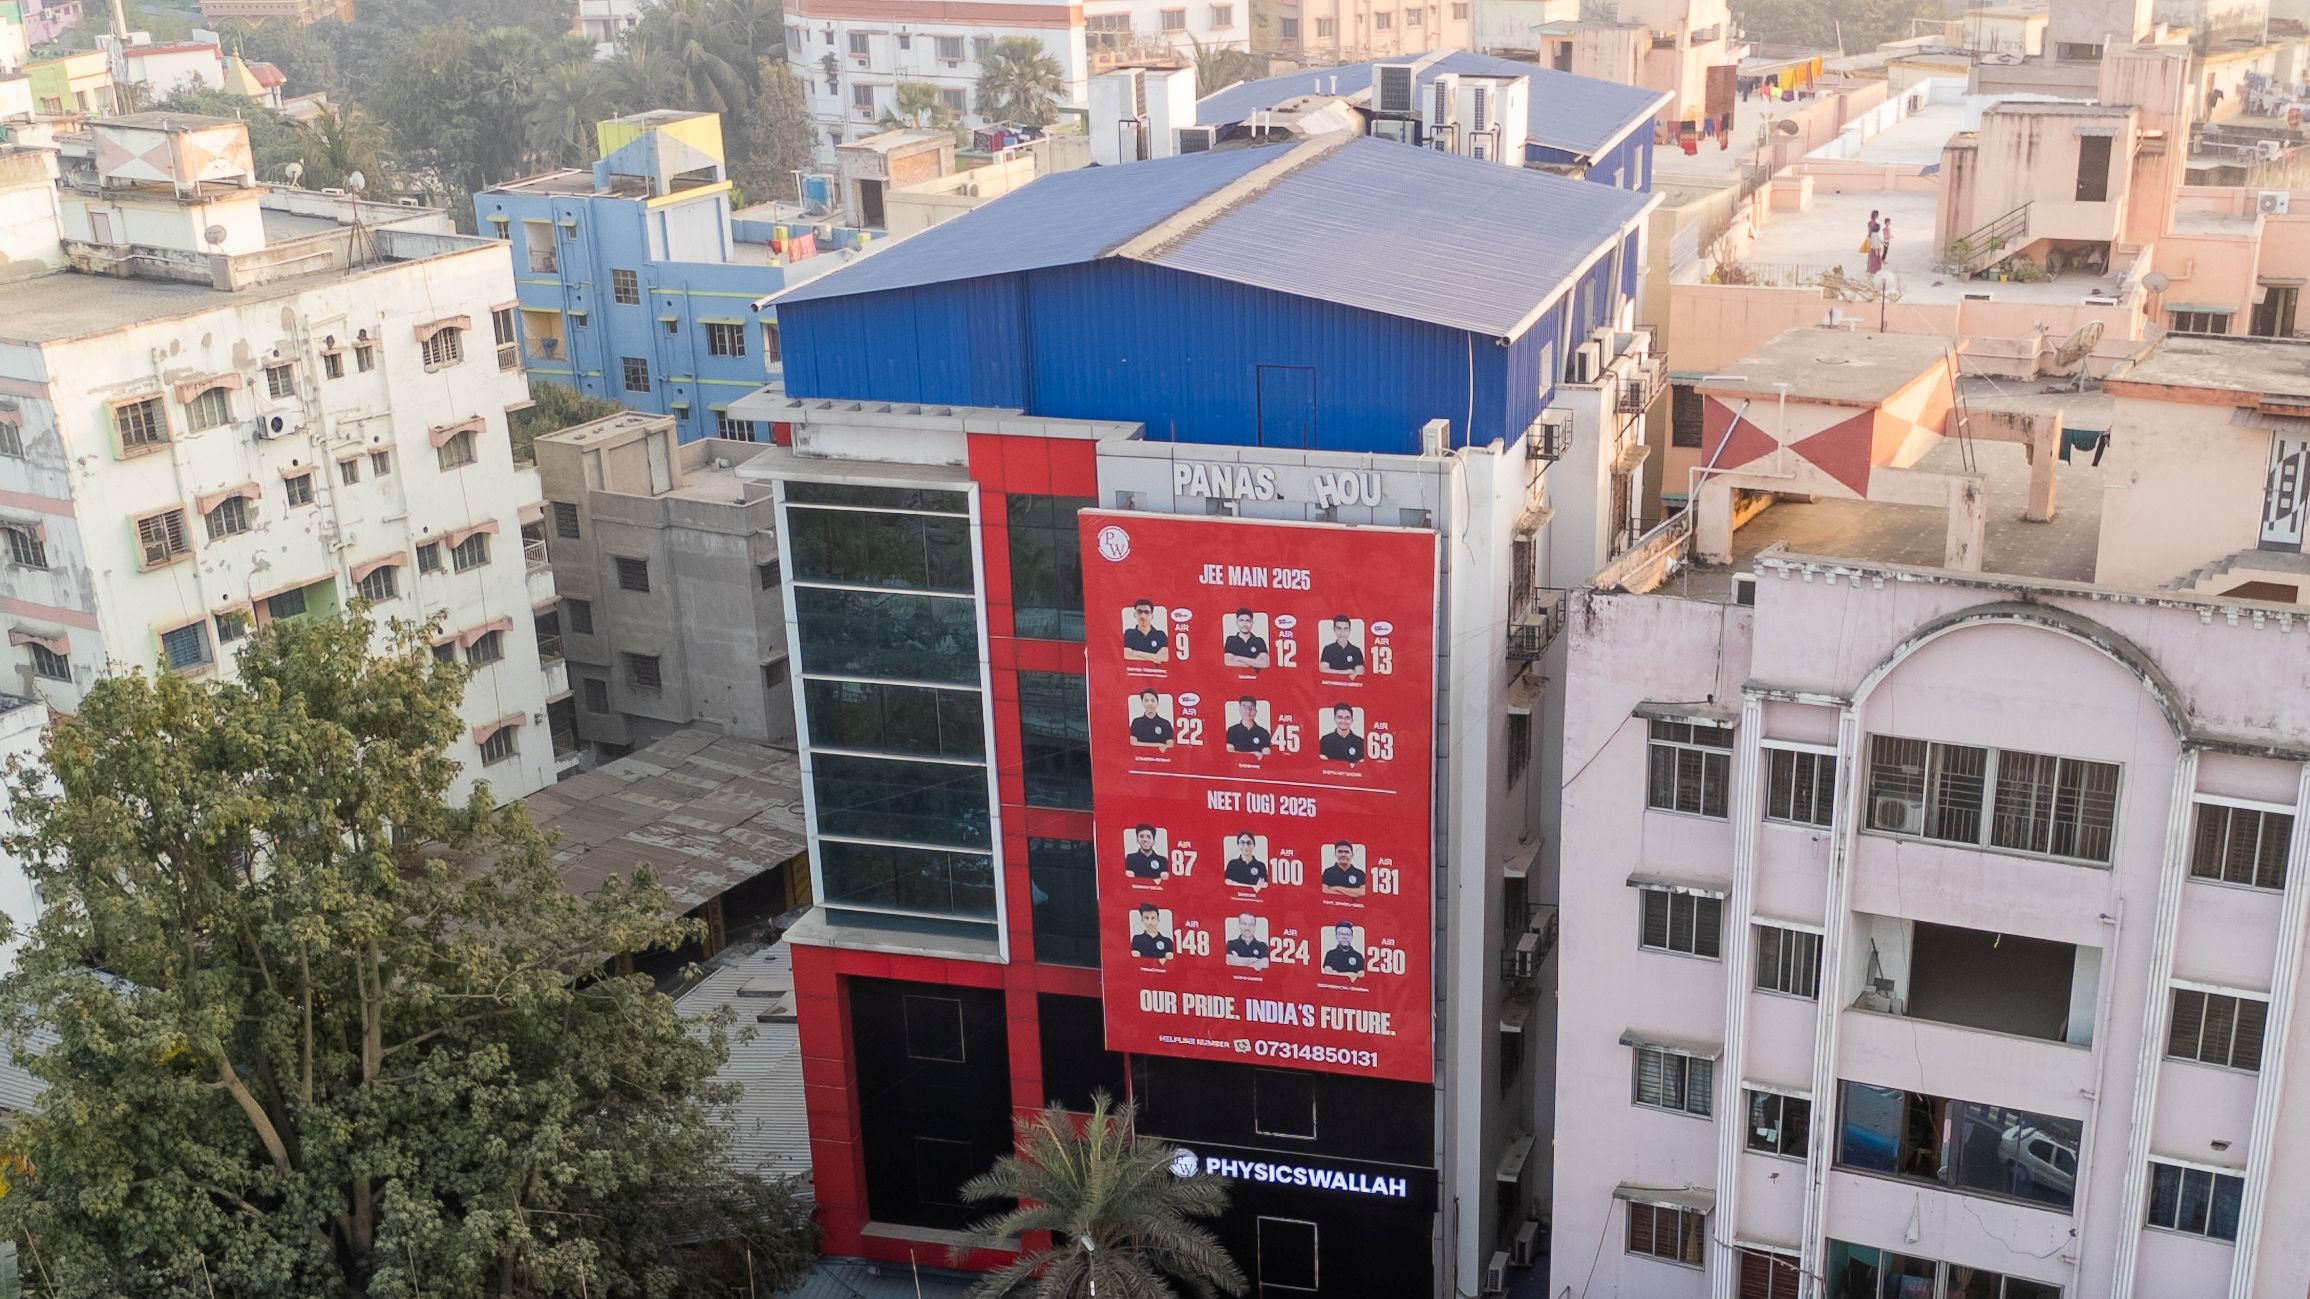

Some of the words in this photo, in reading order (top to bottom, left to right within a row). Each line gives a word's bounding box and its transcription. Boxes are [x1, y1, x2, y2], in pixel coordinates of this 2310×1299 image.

[1199, 564, 1224, 585] JEE
[1228, 565, 1268, 588] MAIN
[1273, 568, 1311, 591] 2025
[1175, 633, 1190, 661] 9
[1275, 639, 1297, 668] 12
[1371, 646, 1393, 675] 13
[1176, 717, 1203, 746] 22
[1271, 724, 1300, 752] 45
[1367, 732, 1394, 761] 63
[1207, 790, 1242, 811] NEET
[1246, 792, 1275, 815] (UG)
[1279, 796, 1317, 818] 2025
[1171, 849, 1198, 876] 87
[1270, 858, 1304, 886] 100
[1370, 867, 1399, 895] 131
[1174, 929, 1210, 956] 148
[1270, 937, 1310, 965] 224
[1367, 946, 1405, 975] 230
[1140, 989, 1177, 1014] OUR
[1182, 992, 1240, 1020] PRIDE.
[1246, 998, 1315, 1027] INDIA'S
[1320, 1006, 1396, 1036] FUTURE.
[1254, 1040, 1378, 1067] 07314850131
[1206, 1157, 1406, 1198] PHYSICSWALLAH
